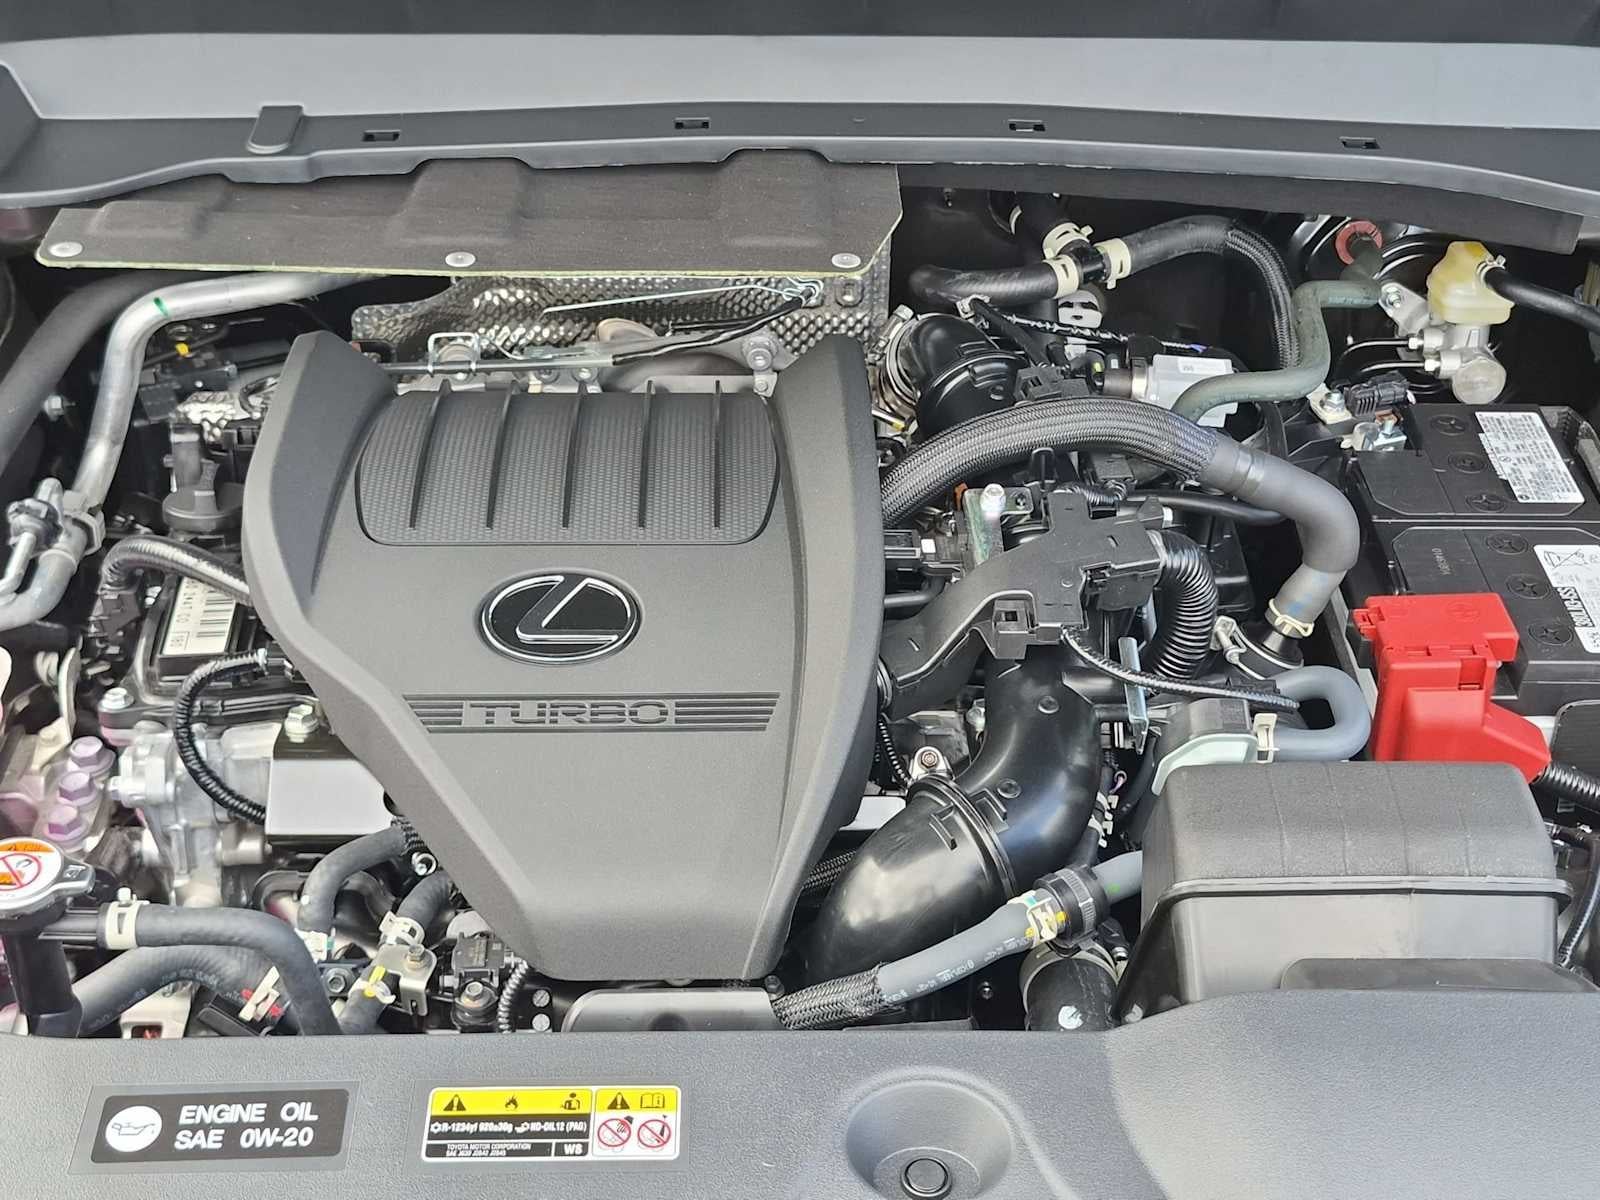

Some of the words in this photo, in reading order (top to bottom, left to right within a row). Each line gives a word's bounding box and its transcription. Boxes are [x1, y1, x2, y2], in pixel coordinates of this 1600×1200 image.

[469, 701, 669, 725] TURBO
[178, 1103, 267, 1126] ENGINE
[280, 1102, 319, 1123] OIL
[174, 1129, 225, 1150] SAE
[239, 1127, 314, 1149] 0W-20
[469, 1143, 490, 1151] MOTOR
[490, 1143, 532, 1151] CORPORATION
